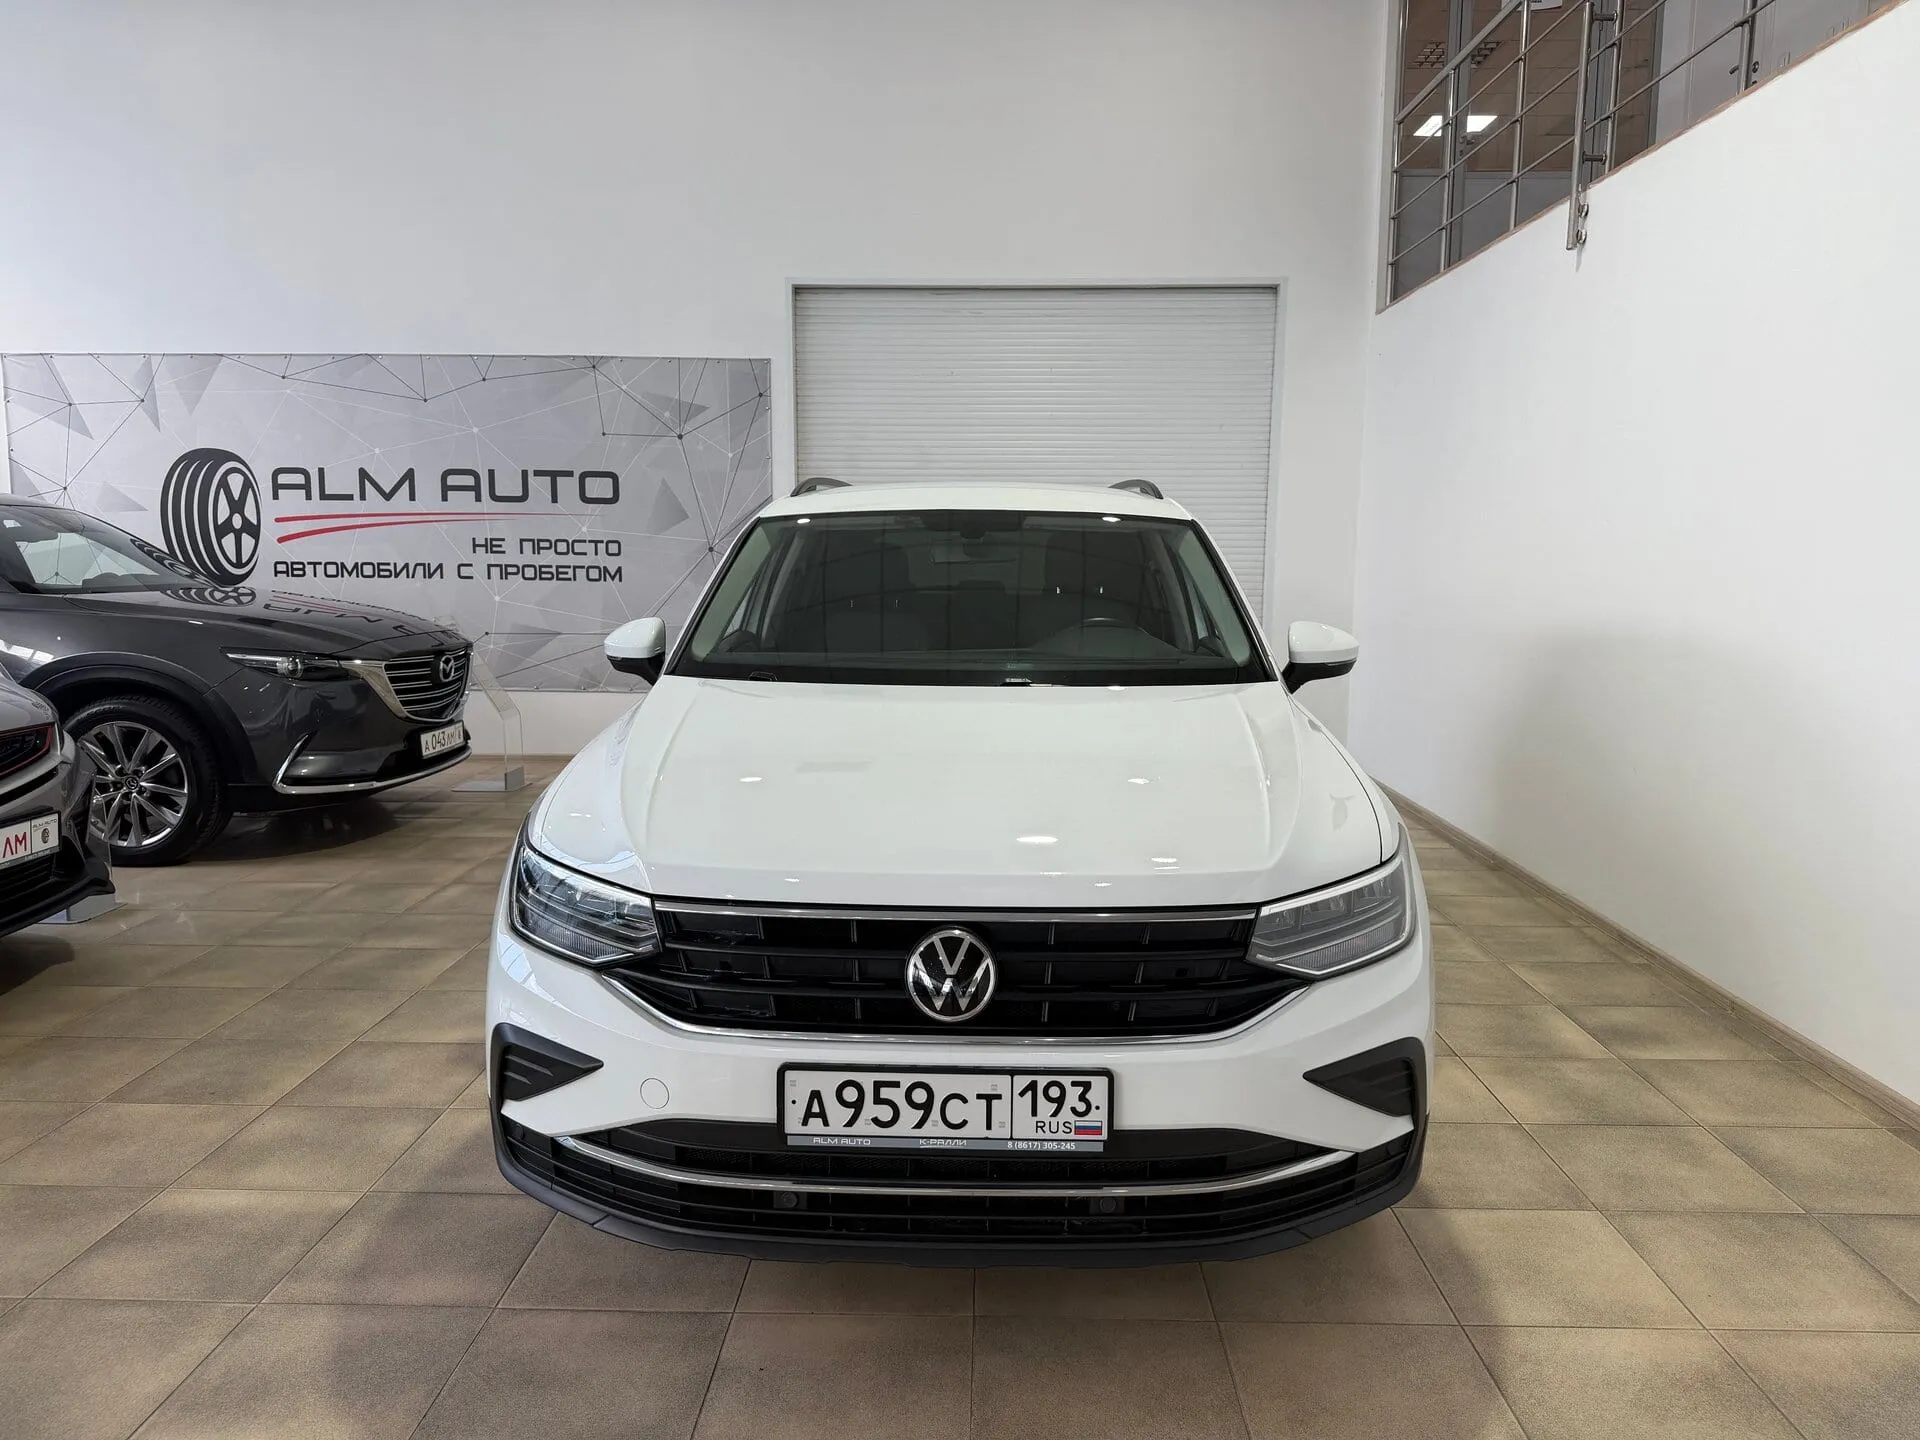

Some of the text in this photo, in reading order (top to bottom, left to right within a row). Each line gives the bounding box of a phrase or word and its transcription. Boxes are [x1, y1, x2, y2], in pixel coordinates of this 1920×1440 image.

[271, 467, 620, 505] ALM AUTO
[472, 537, 622, 557] НЕ ПРОСТО
[273, 561, 623, 582] АВТОМОБИЛИ С ПРОБЕГОМ
[1017, 1080, 1093, 1118] 193
[1036, 1120, 1073, 1134] RUS
[813, 1137, 871, 1146] ALM AUTO
[1014, 1142, 1041, 1150] (8617)
[1043, 1142, 1076, 1150] 305-245
